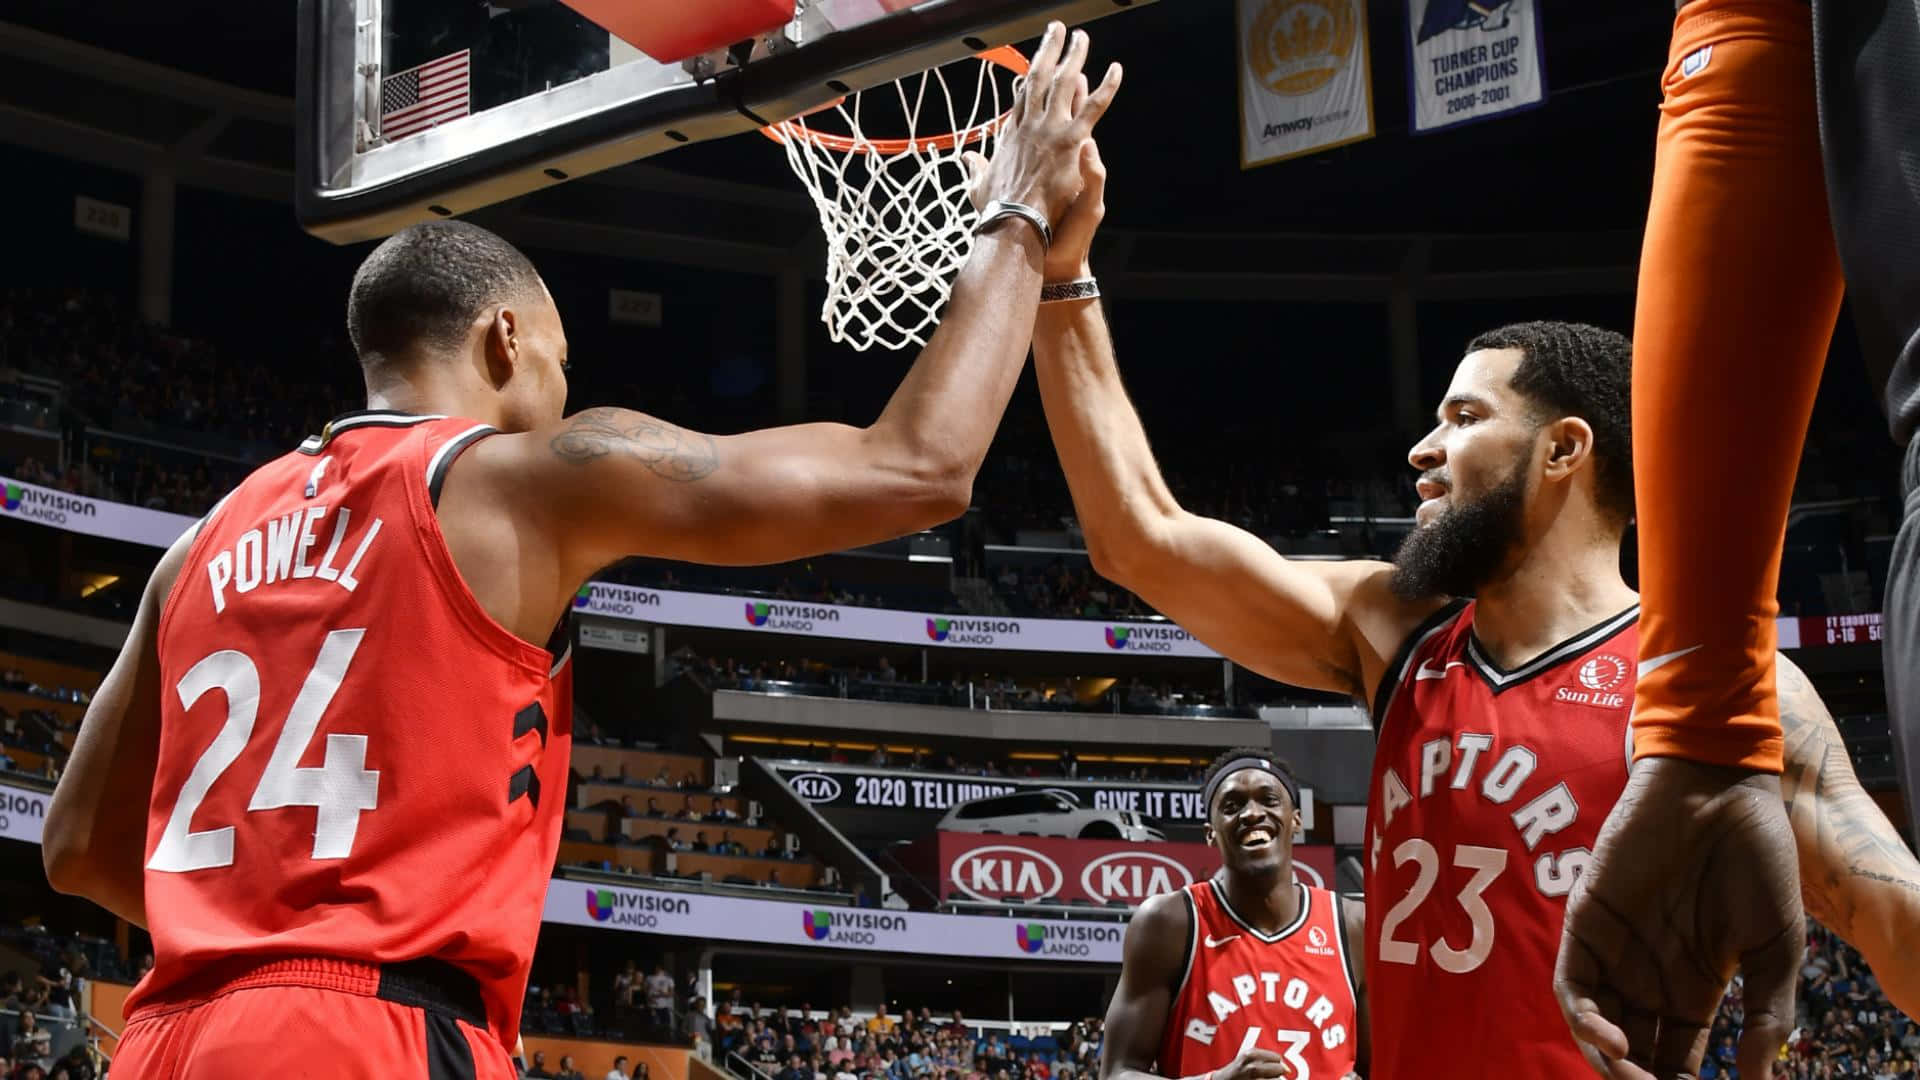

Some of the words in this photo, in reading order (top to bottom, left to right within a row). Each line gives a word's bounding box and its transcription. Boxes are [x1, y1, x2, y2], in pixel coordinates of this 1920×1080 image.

[1432, 45, 1488, 75] TURNER
[1491, 36, 1520, 60] CUP
[1435, 58, 1519, 96] CHAMPIONS
[1447, 86, 1511, 114] 2000-2001
[1263, 116, 1313, 138] Amway
[20, 504, 67, 524] LANDO
[207, 505, 383, 614] POWELL
[590, 600, 633, 615] LANDO
[1840, 613, 1884, 627] SHOOTIN
[768, 618, 813, 632] LANDO
[948, 634, 994, 645] LANDO
[1128, 641, 1172, 652] LANDO
[1556, 686, 1590, 704] Sun
[1591, 691, 1624, 707] Life
[146, 628, 381, 873] 24
[797, 778, 832, 797] KIA
[855, 777, 906, 806] 2020
[1094, 790, 1139, 812] GIVE
[1143, 792, 1164, 817] IT
[1170, 793, 1206, 820] EVE
[971, 858, 1044, 894] KIA
[1101, 864, 1177, 897] KIA
[1379, 838, 1509, 974] 23
[1184, 972, 1347, 1050] RAPTORS
